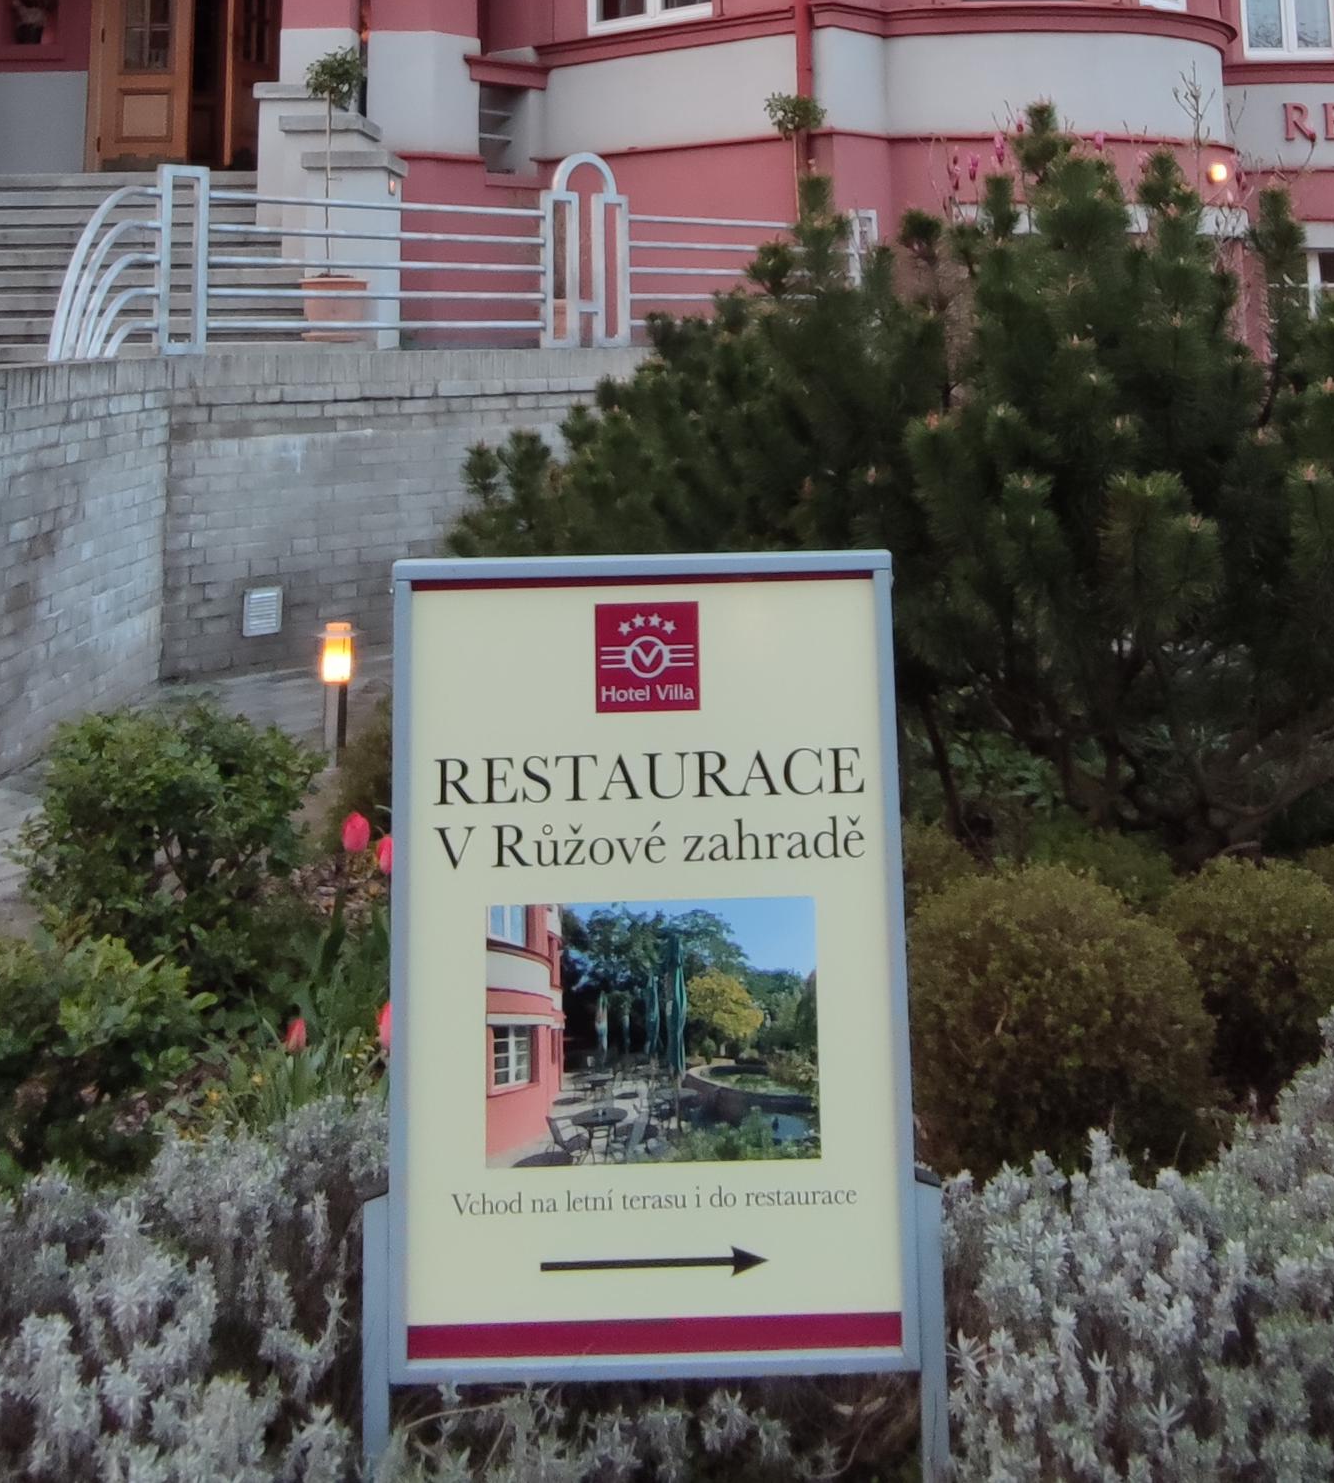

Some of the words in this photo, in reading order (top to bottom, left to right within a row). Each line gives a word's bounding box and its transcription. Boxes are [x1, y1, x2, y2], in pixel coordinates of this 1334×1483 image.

[601, 684, 651, 703] Hotel
[655, 683, 695, 701] Villa
[433, 746, 865, 807] RESTAURACE
[433, 826, 476, 870] V
[491, 820, 666, 868] Růžové
[683, 815, 865, 863] zahradě
[451, 1191, 522, 1216] Vchod
[531, 1197, 559, 1213] na
[566, 1188, 613, 1212] letní
[622, 1193, 688, 1211] terasu
[694, 1186, 702, 1208] i
[709, 1185, 737, 1208] do
[745, 1188, 858, 1207] restaurace
